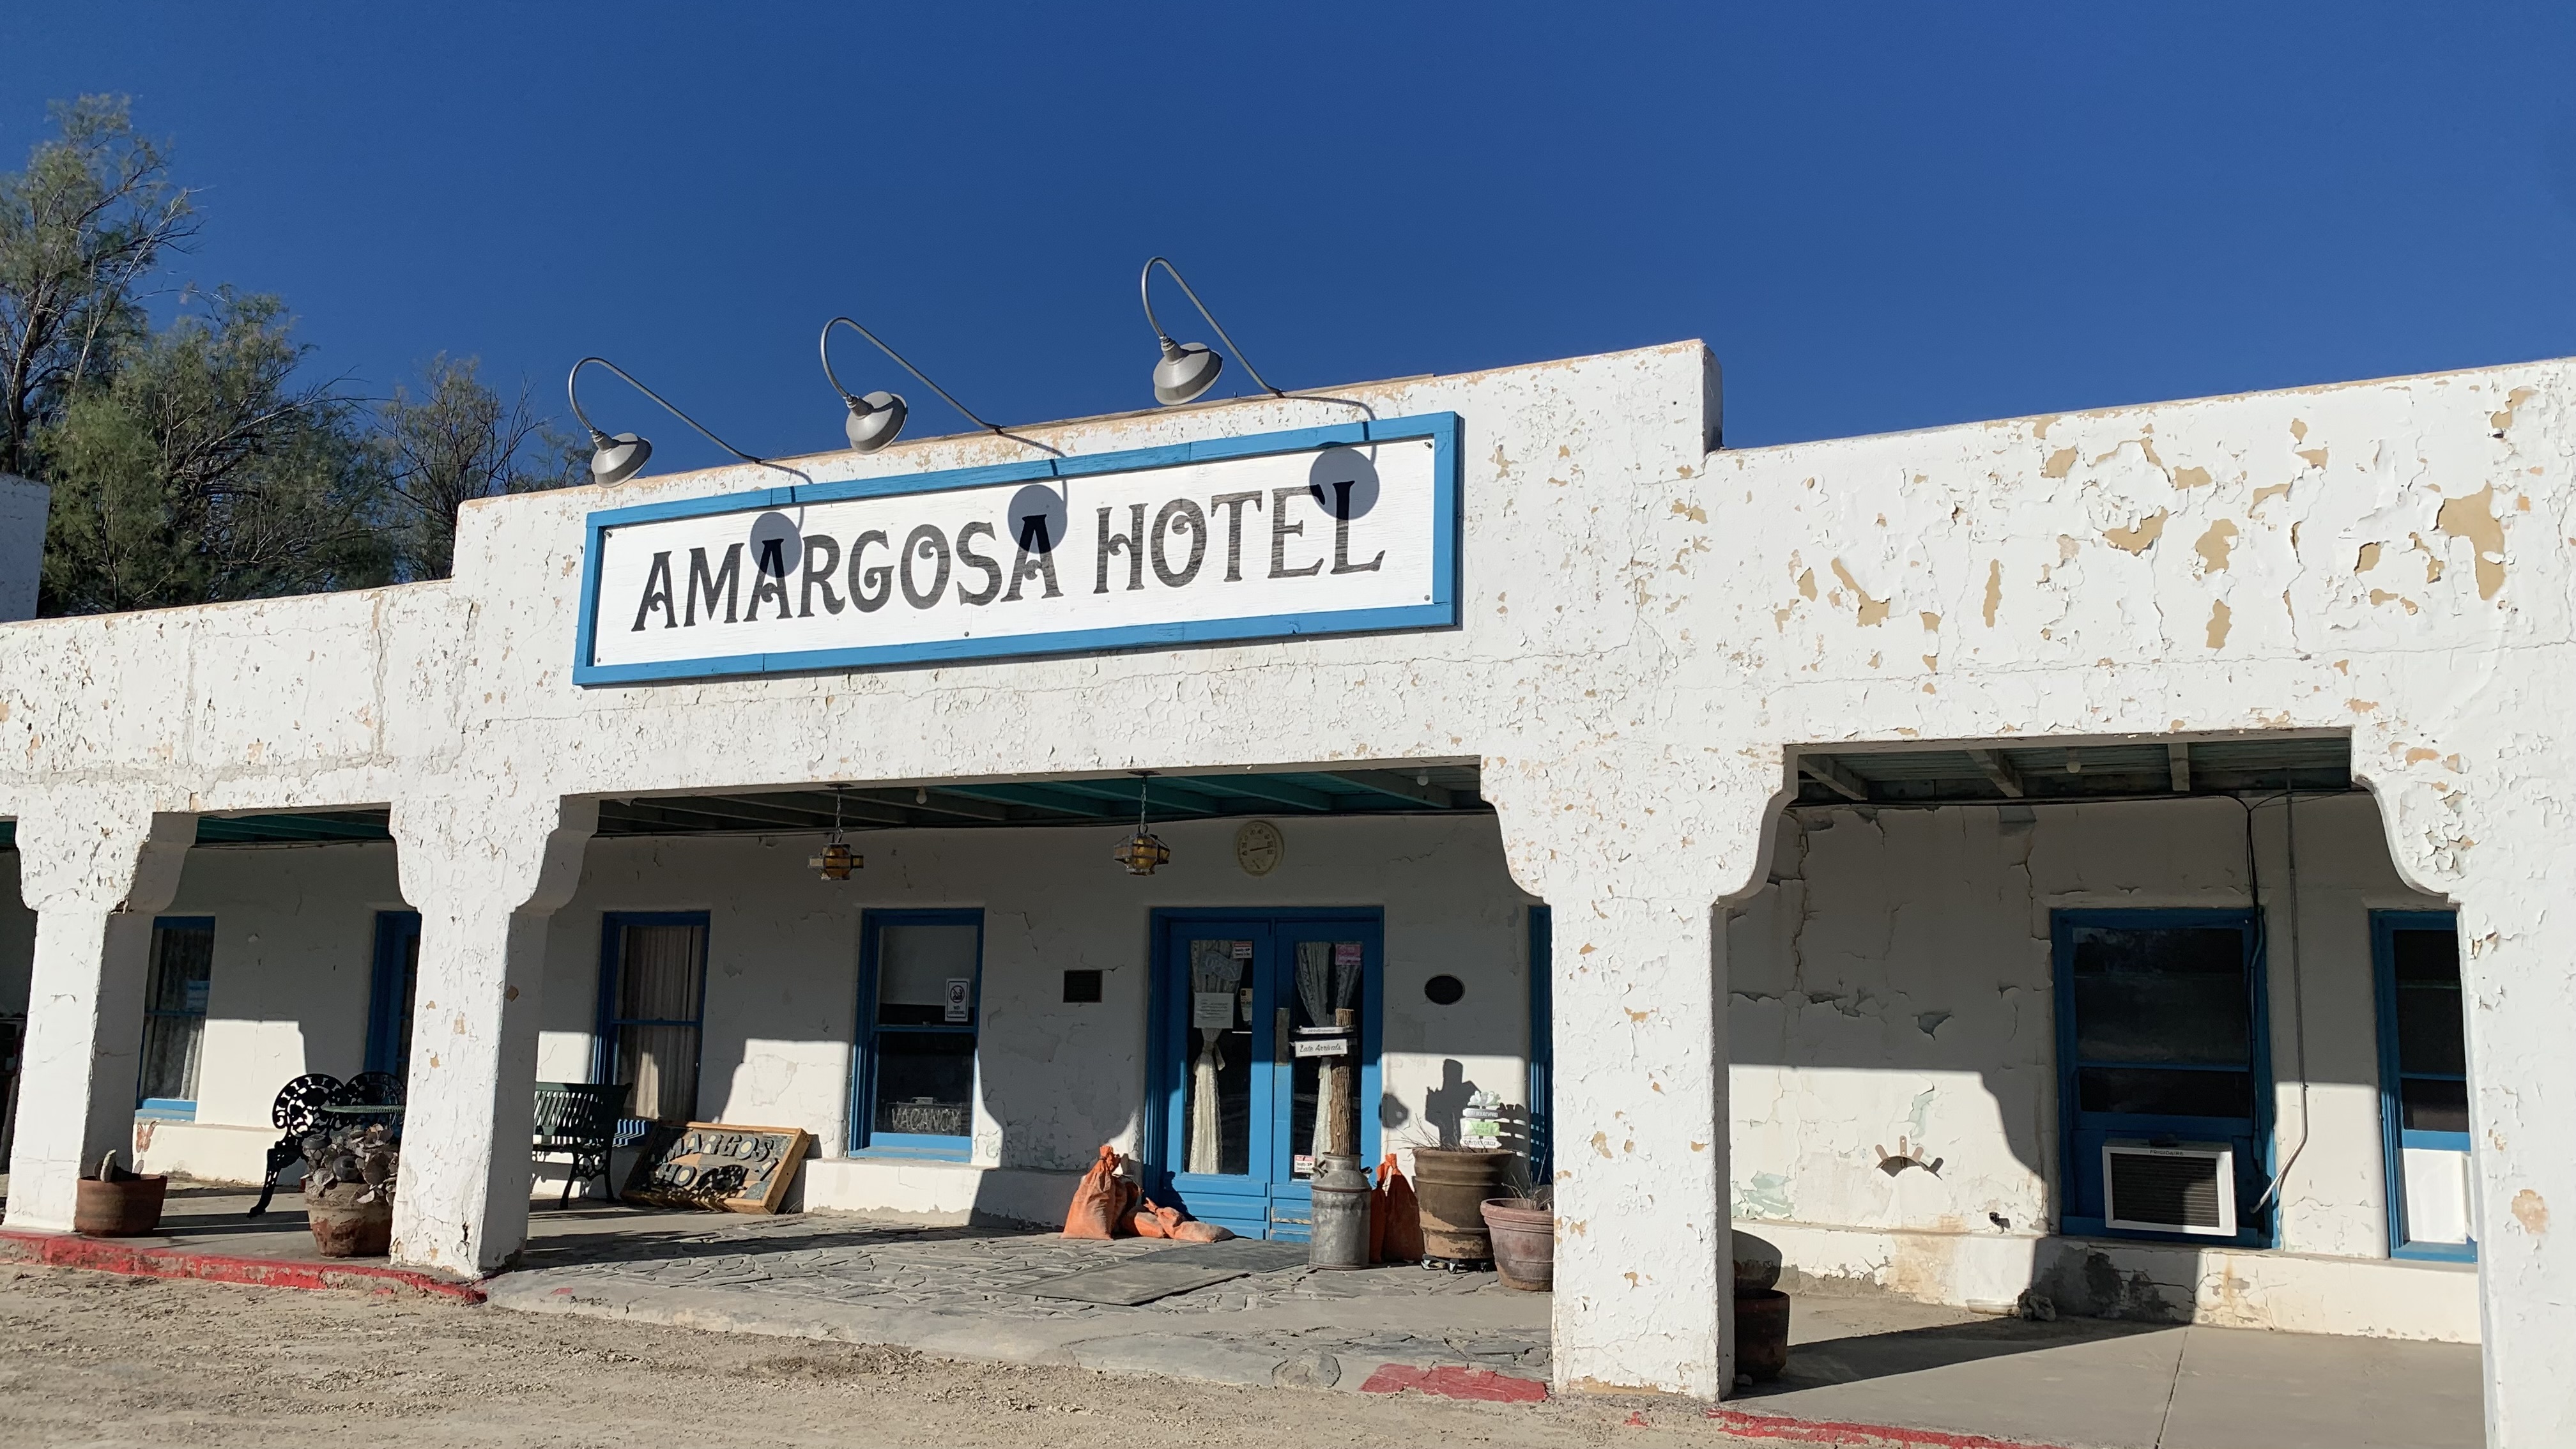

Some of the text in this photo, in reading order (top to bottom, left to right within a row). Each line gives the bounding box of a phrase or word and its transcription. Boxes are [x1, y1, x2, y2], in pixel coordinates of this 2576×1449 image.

[631, 480, 1386, 632] AMARGOSA HOTEL
[1300, 1043, 1342, 1052] Late Arrivals
[892, 1108, 961, 1132] VACANCY
[650, 1133, 779, 1181] MARGOSA
